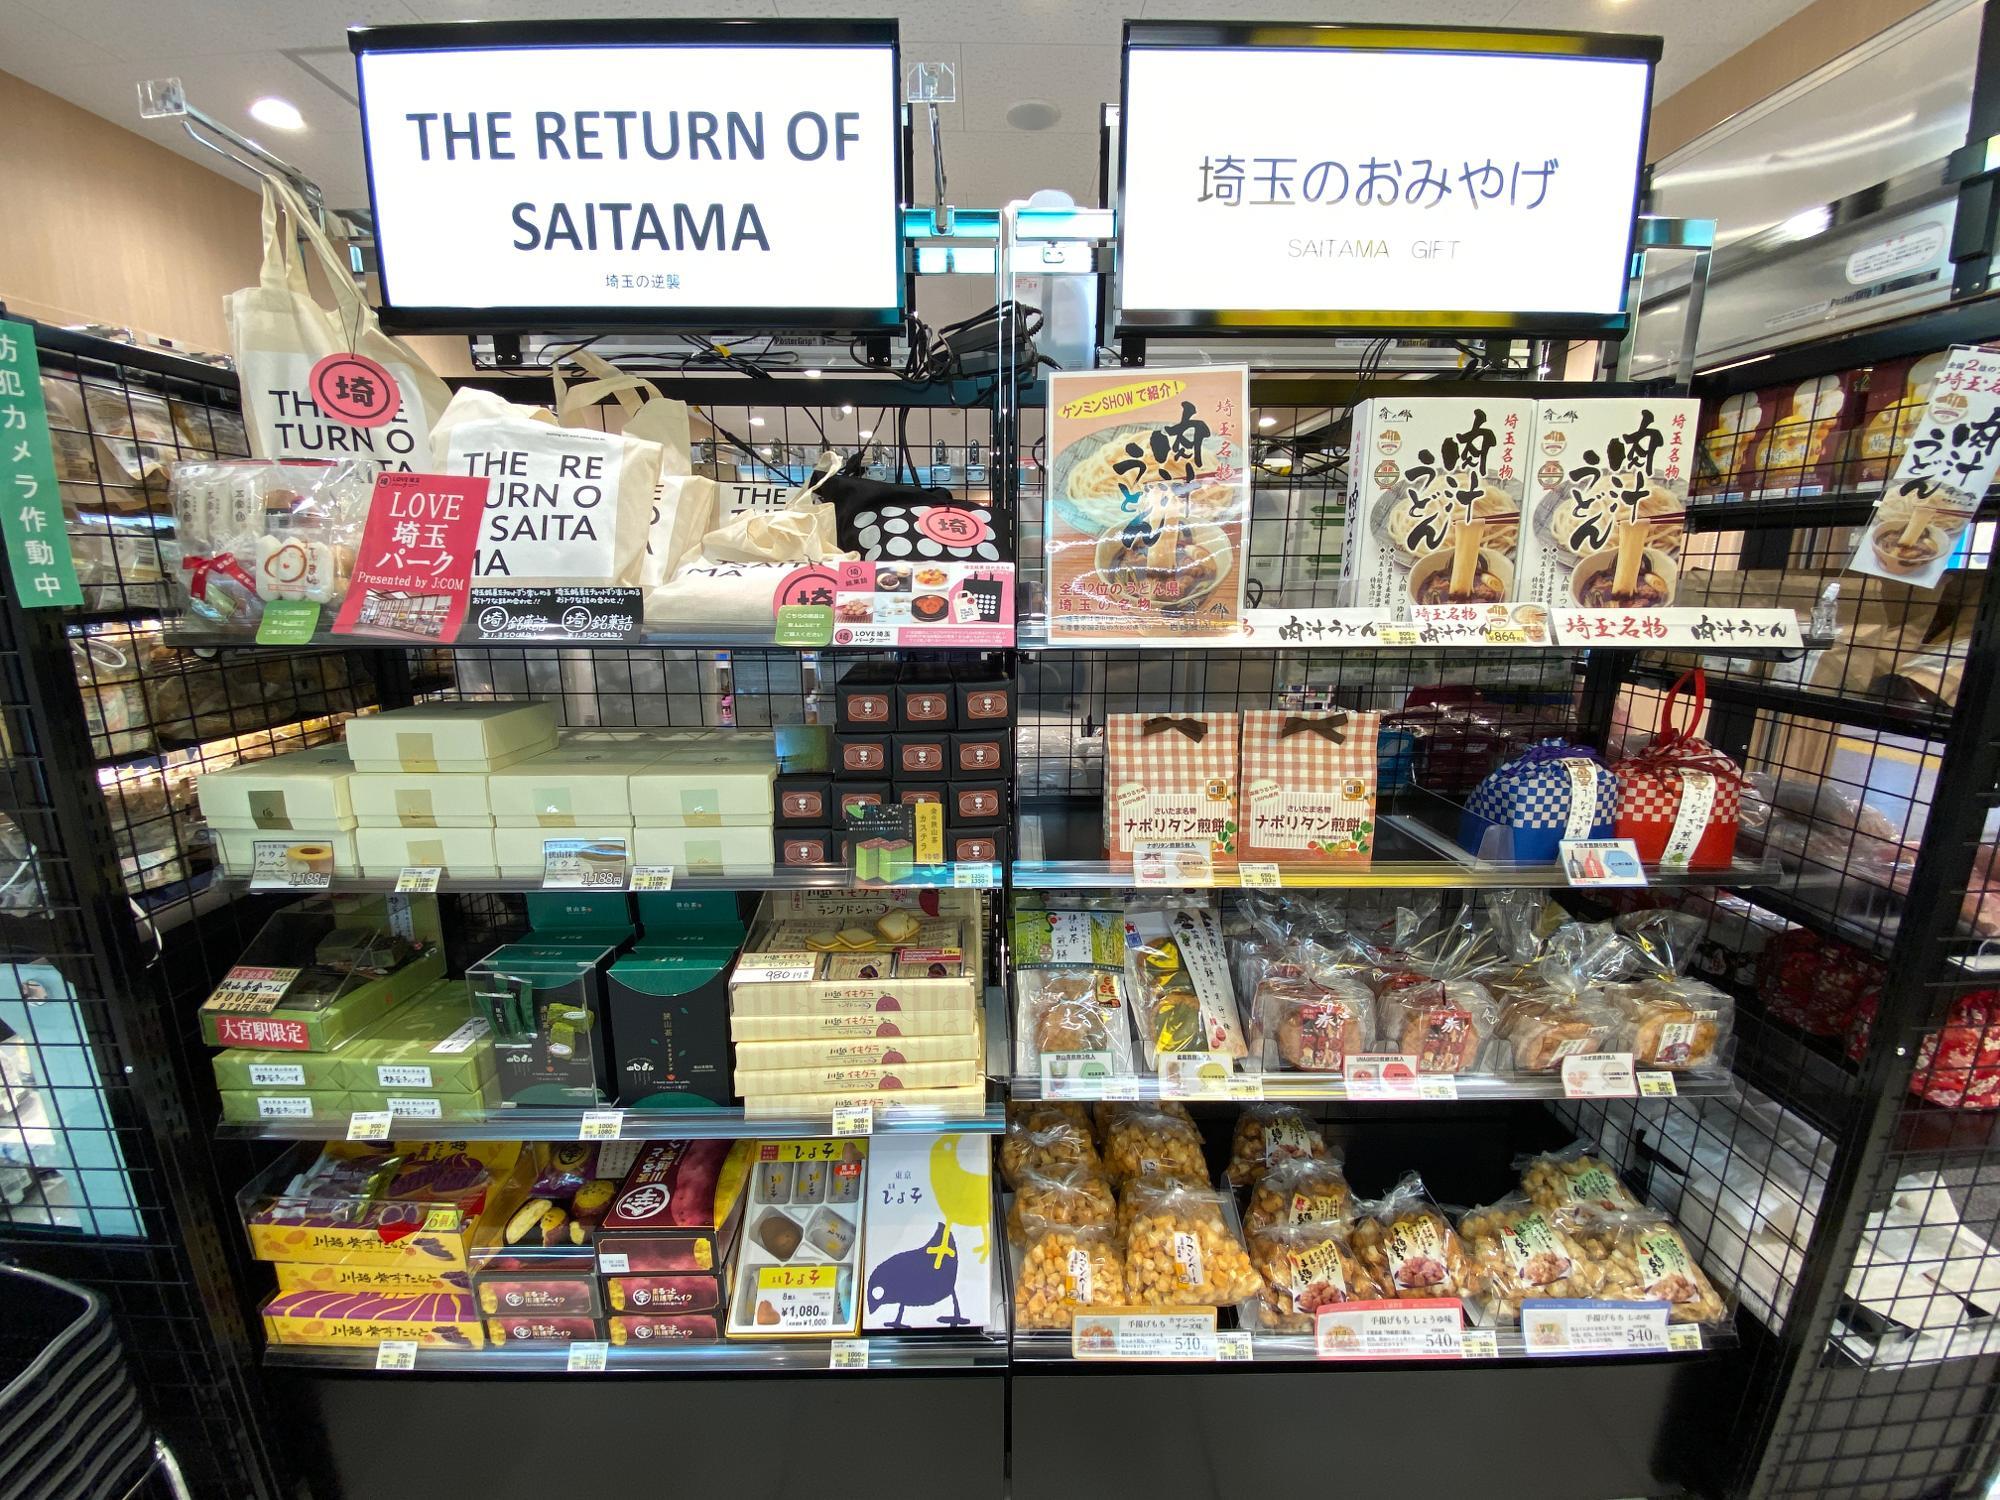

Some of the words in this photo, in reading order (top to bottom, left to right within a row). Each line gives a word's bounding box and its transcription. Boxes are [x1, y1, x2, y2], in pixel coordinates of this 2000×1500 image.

[406, 111, 516, 161] THE
[535, 110, 765, 161] RETURN
[786, 110, 860, 161] OF
[1197, 154, 1559, 210] 埼玉のおみやげ
[511, 202, 770, 251] SAITAMA
[1288, 239, 1389, 259] SAITAMA
[1411, 239, 1460, 259] GIFT
[605, 273, 680, 290] 埼玉の逆襲
[336, 376, 375, 407] 埼
[268, 390, 332, 418] TH
[275, 423, 375, 452] TURN
[386, 429, 415, 454] O
[1216, 399, 1235, 480] 埼玉名物
[1499, 413, 1520, 480] 埼玉名物
[1664, 414, 1688, 480] 埼玉名物
[464, 452, 528, 476] THE
[559, 456, 603, 479] RE
[1901, 428, 1945, 499] うどん
[484, 483, 560, 508] URN
[573, 485, 602, 508] O
[733, 486, 786, 504] THE
[1404, 449, 1448, 551] うどん
[1568, 449, 1614, 551] うどん
[389, 491, 465, 520] LOVE
[392, 521, 449, 549] 埼玉
[489, 514, 598, 542] SAITA
[938, 518, 968, 535] 埼
[376, 548, 454, 576] パーク
[357, 571, 412, 587] Presented
[415, 576, 428, 588] by
[431, 577, 464, 590] J:COM
[1059, 598, 1151, 611] 埼玉の名物
[483, 611, 503, 628] 埼
[566, 611, 588, 628] 埼
[1415, 607, 1477, 622] 埼玉名物
[1278, 615, 1377, 642] 肉汁うどん
[1420, 624, 1491, 643] 肉汁うどん
[1565, 614, 1669, 640] 埼玉名物
[1690, 614, 1788, 641] 肉汁うどん
[1154, 807, 1198, 816] さいたま名物
[1286, 805, 1332, 815] さいたま名物
[1123, 816, 1226, 833] ナポリタン煎餅
[1255, 814, 1361, 832] ナポリタン煎餅
[288, 872, 330, 887] 1,188円
[581, 872, 621, 886] 1,188円
[213, 992, 258, 1004] 900円
[221, 1019, 304, 1044] 大宮駅限定
[795, 1142, 835, 1160] ひよ子
[895, 1171, 912, 1180] 東京
[882, 1187, 922, 1205] ひよ子
[313, 1235, 345, 1248] 川越
[340, 1271, 371, 1284] 川越
[784, 1269, 820, 1285] ひよ子
[652, 1287, 677, 1295] まるっと
[781, 1305, 820, 1319] ¥1,080
[1371, 1315, 1410, 1325] 手揚げもち
[1413, 1315, 1453, 1324] しょうゆ味
[331, 1324, 363, 1337] 川越
[1128, 1320, 1166, 1329] 手揚げもち
